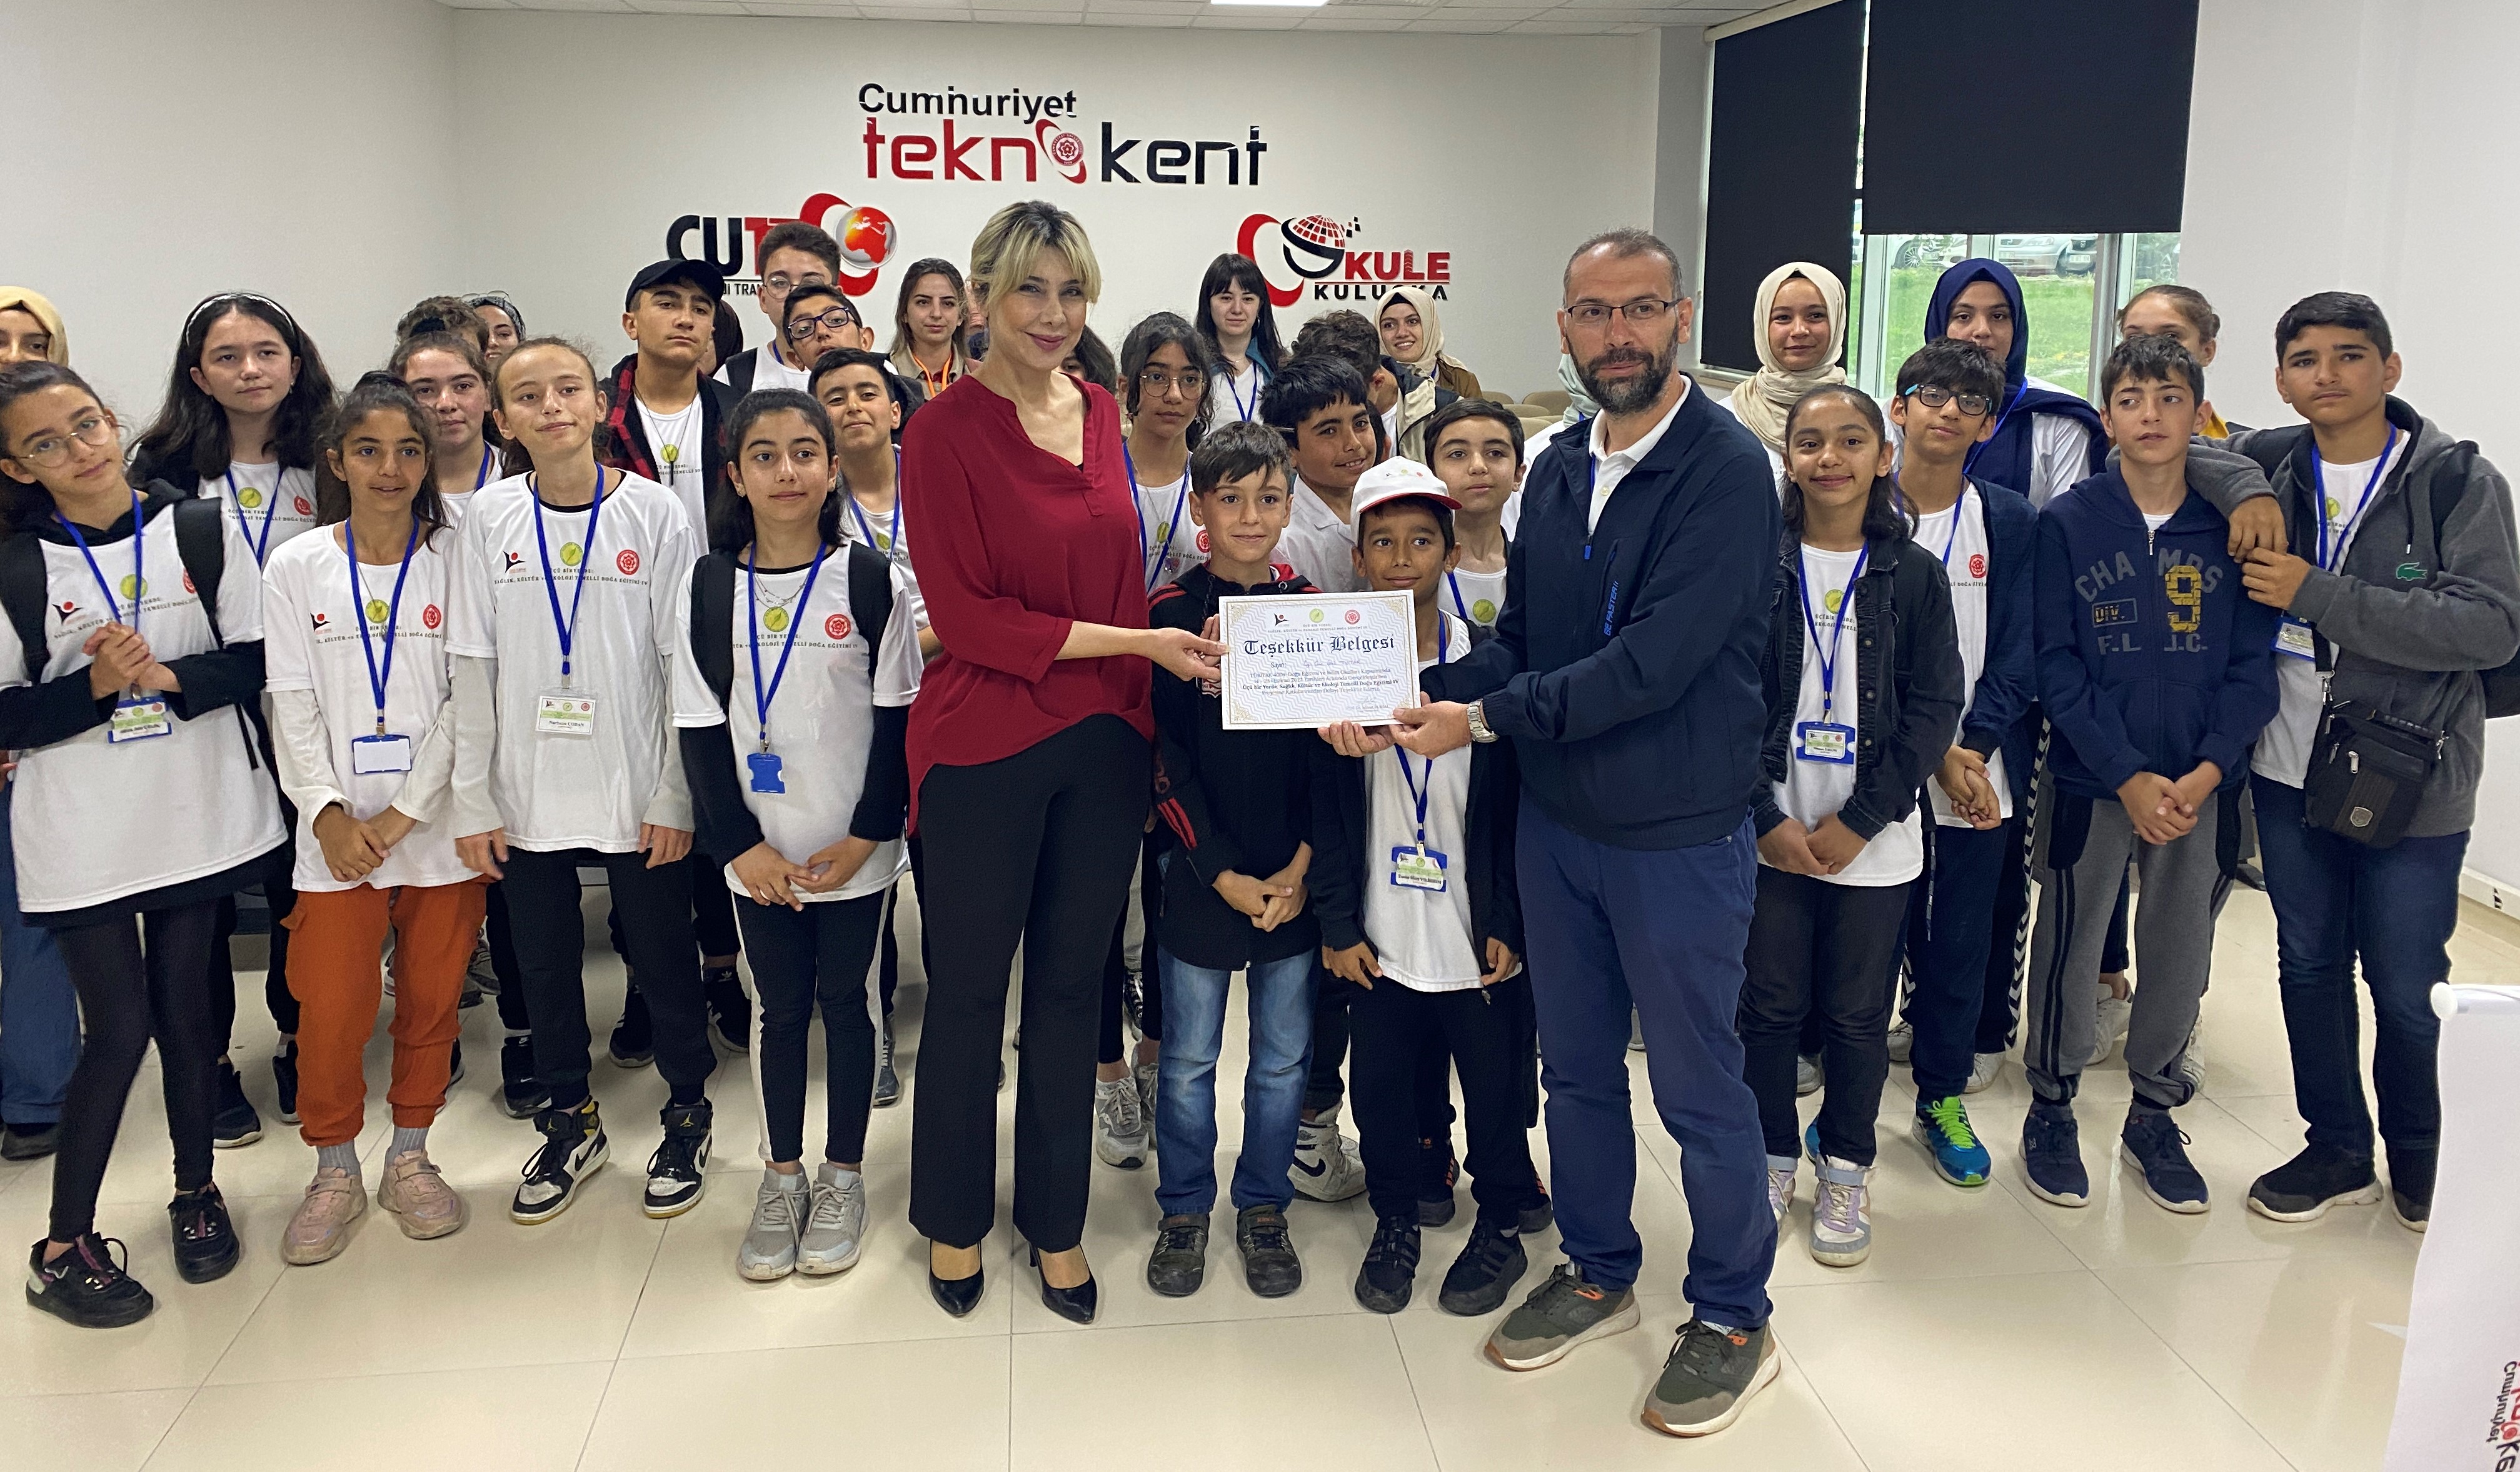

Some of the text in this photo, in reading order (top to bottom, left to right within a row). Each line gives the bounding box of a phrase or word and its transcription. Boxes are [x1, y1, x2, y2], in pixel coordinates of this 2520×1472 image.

[858, 83, 1077, 124] Cumhuriyet
[2165, 565, 2202, 633] 9
[1243, 634, 1394, 658] Teşekkür Belgesi
